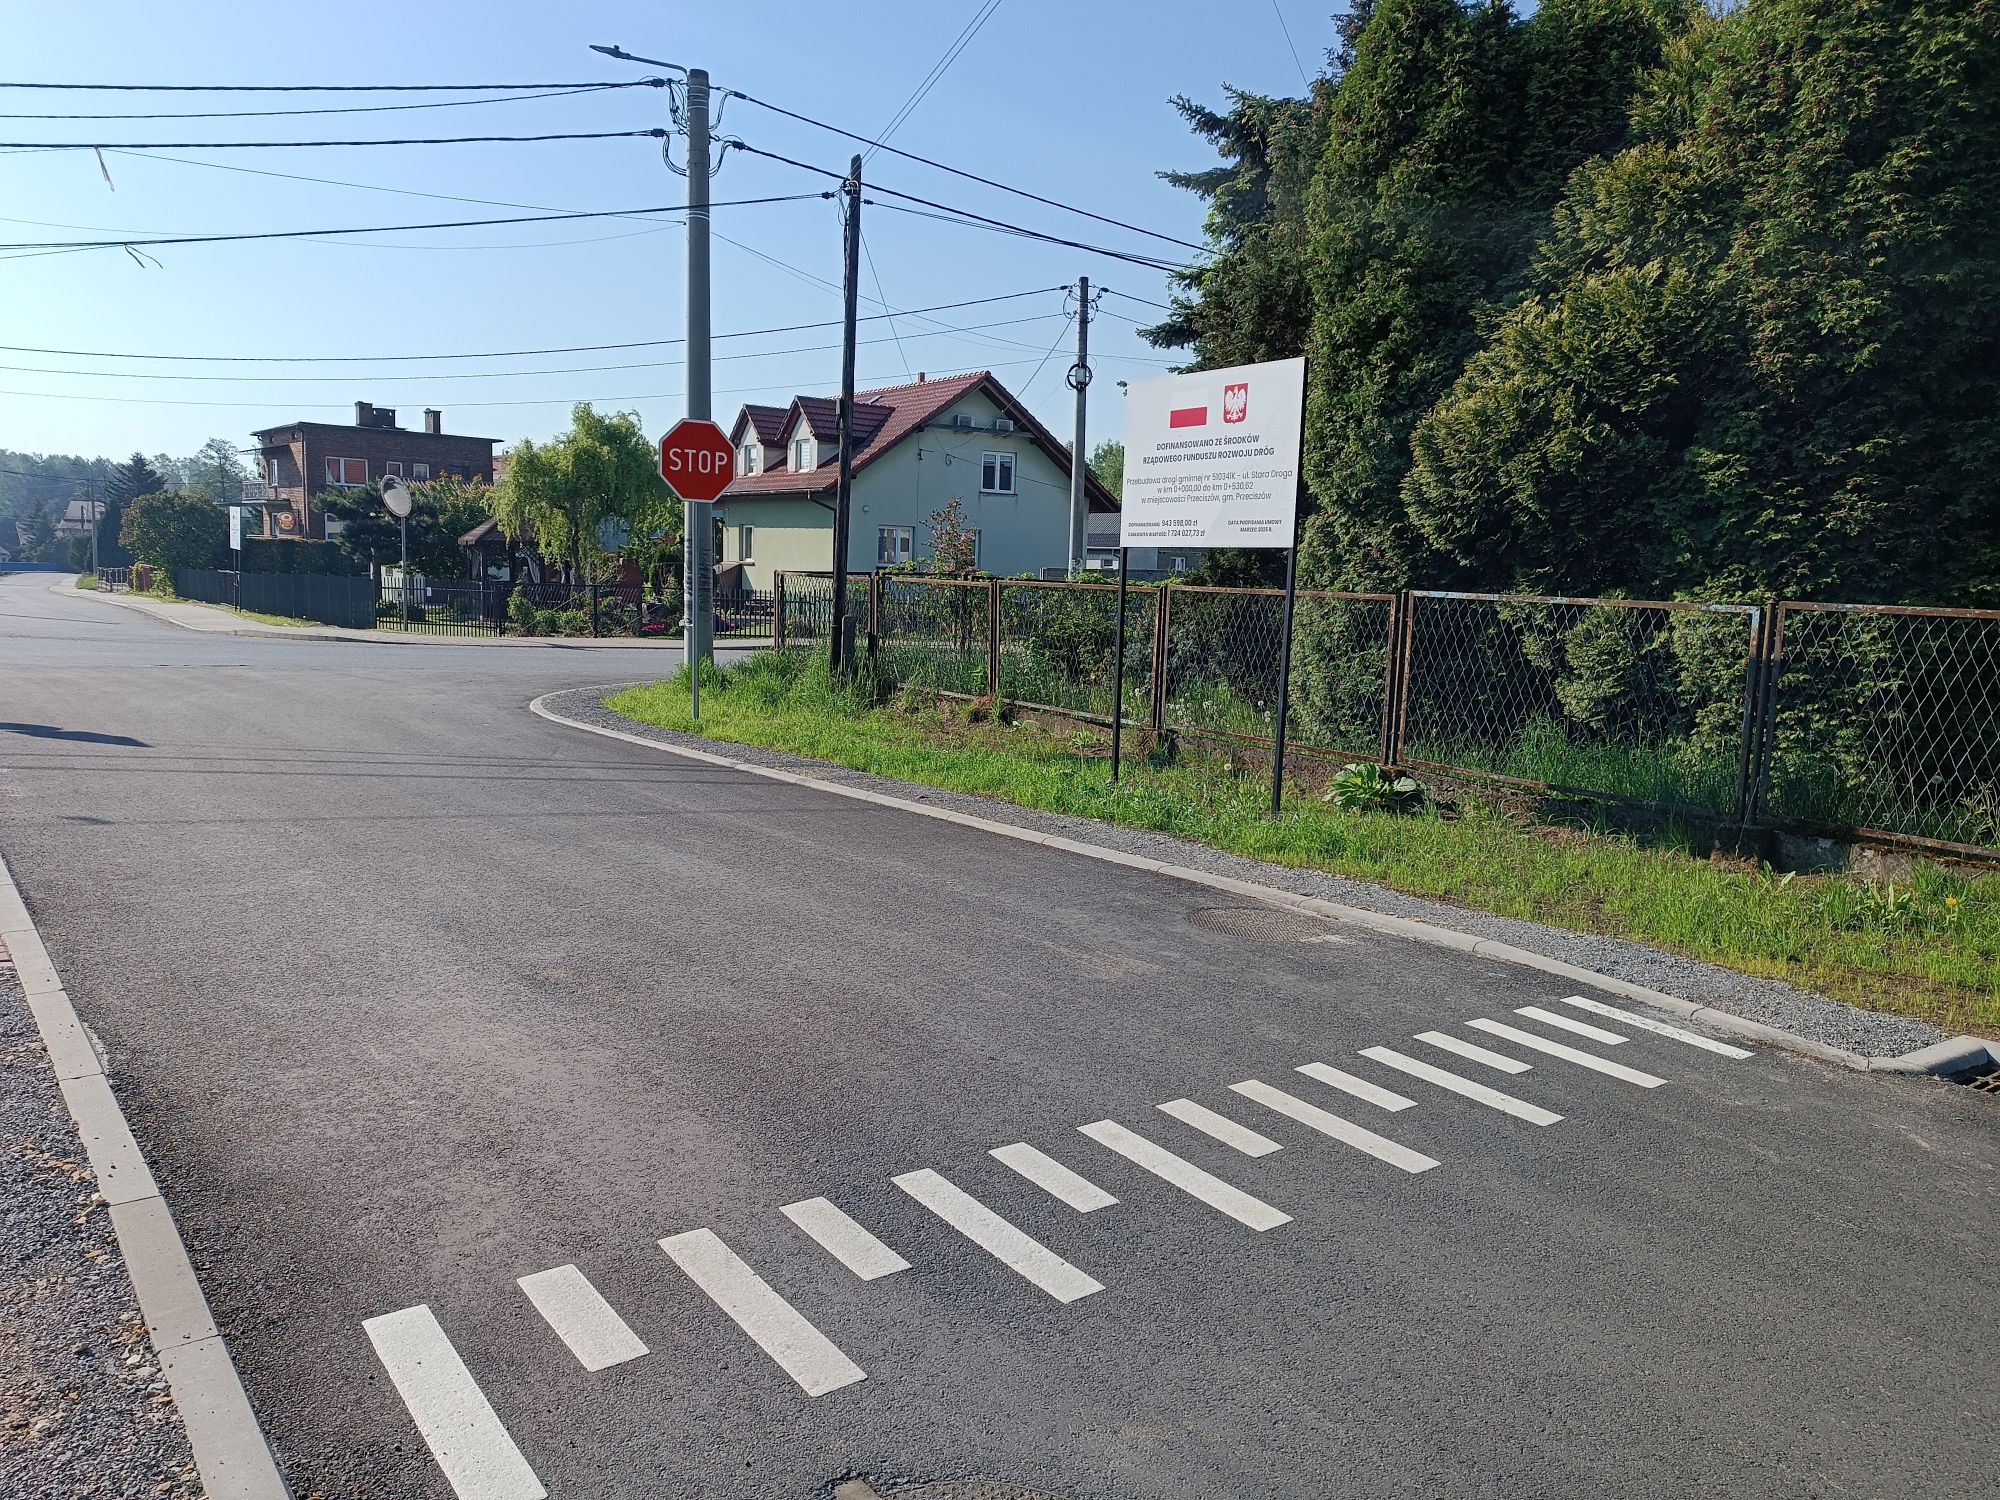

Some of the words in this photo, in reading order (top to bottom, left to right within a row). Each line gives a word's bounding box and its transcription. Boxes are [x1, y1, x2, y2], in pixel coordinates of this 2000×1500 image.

[1156, 439, 1214, 451] DOFINANSOWANO
[1215, 437, 1223, 446] ZE
[1223, 433, 1260, 445] ŚRODKÓW
[669, 447, 728, 474] STOP
[1142, 454, 1182, 466] RZĄDOWEGO
[1183, 451, 1217, 462] FUNDUSZU
[1217, 449, 1253, 460] ROZWOJU
[1253, 445, 1275, 457] DRÓG
[1126, 477, 1161, 486] Przebudowa
[1161, 474, 1178, 485] drogi
[1178, 473, 1203, 484] gminnej
[1242, 471, 1250, 480] ul.
[1251, 470, 1270, 479] Stara
[1270, 469, 1293, 480] Droga
[1163, 485, 1173, 493] km
[1202, 483, 1211, 492] do
[1212, 483, 1222, 491] km
[1146, 494, 1186, 506] miejscowości
[1186, 492, 1221, 503] Przeciszów,
[1221, 494, 1235, 504] gm.
[1235, 491, 1272, 501] Przeciszów
[1161, 519, 1172, 527] 943
